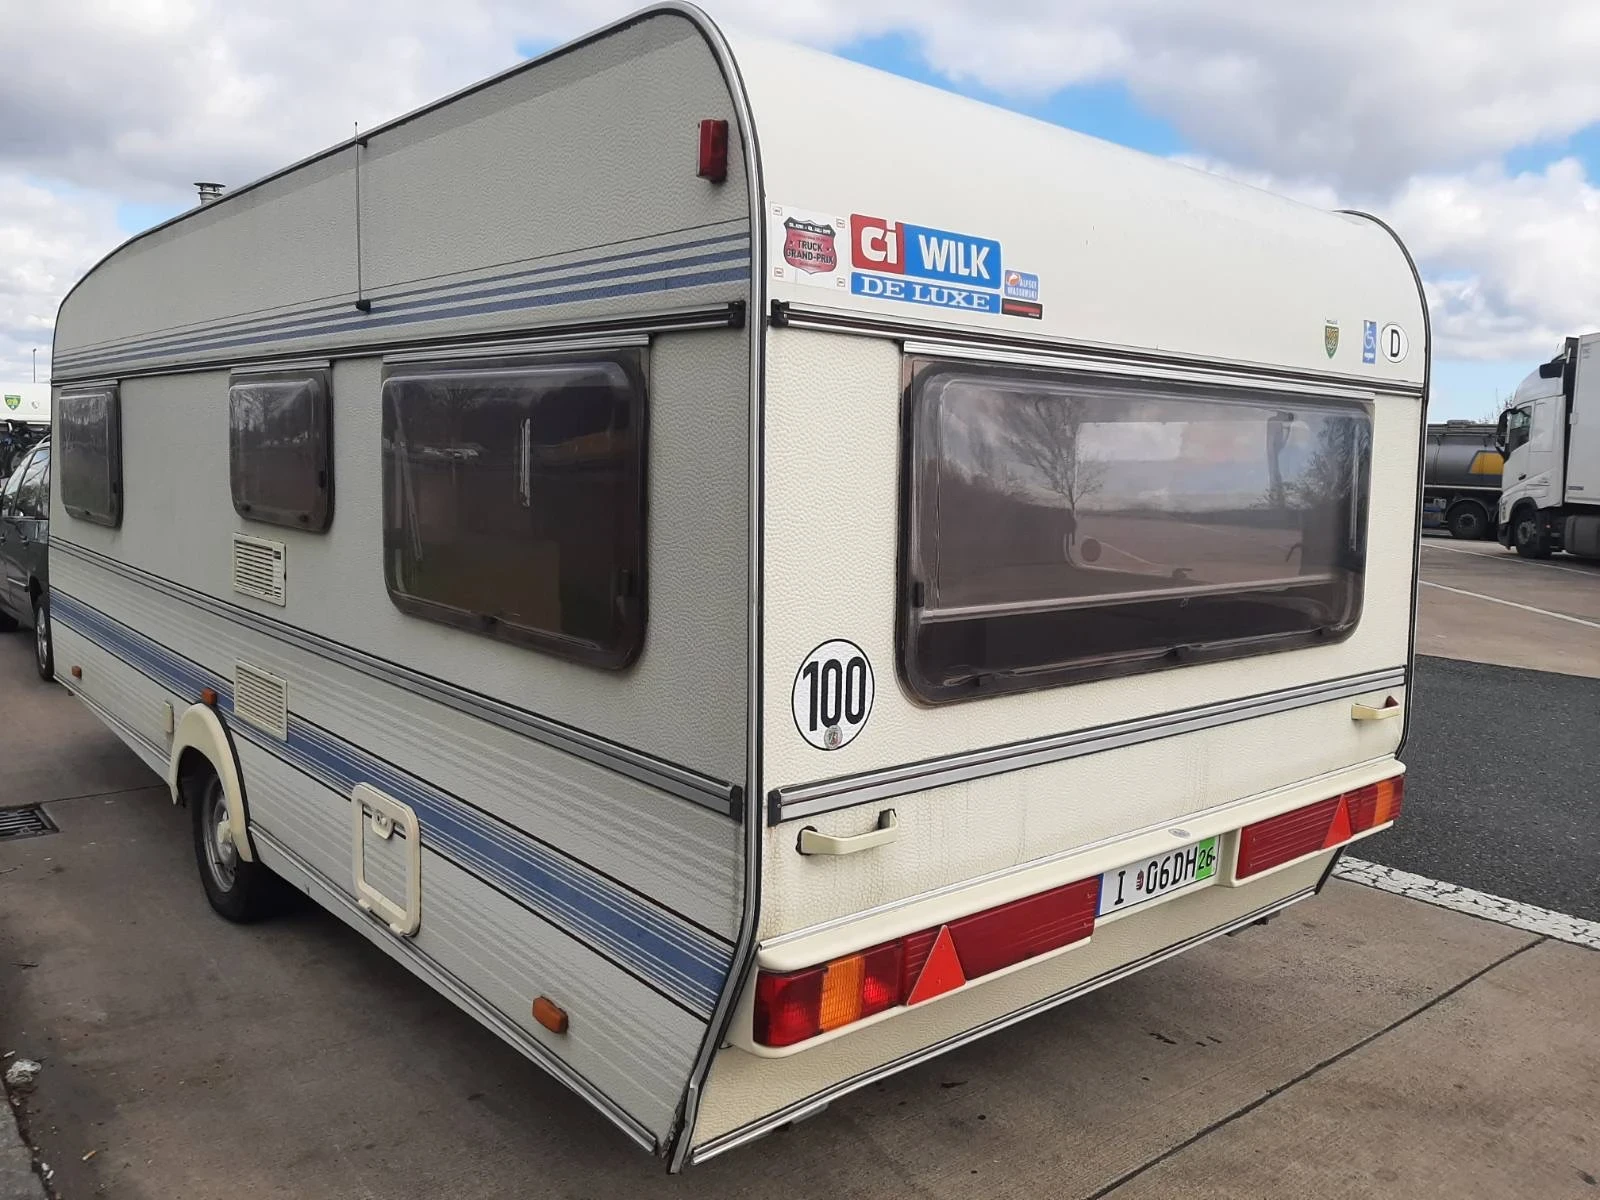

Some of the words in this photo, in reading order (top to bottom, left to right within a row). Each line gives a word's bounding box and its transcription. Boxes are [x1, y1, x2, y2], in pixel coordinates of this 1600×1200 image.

[787, 248, 834, 264] GRAND-PRIX
[798, 240, 823, 252] TRUCK
[918, 234, 990, 279] WILK
[861, 276, 905, 298] DE
[912, 284, 990, 310] LUXE
[1390, 328, 1401, 357] D
[803, 656, 866, 732] 100
